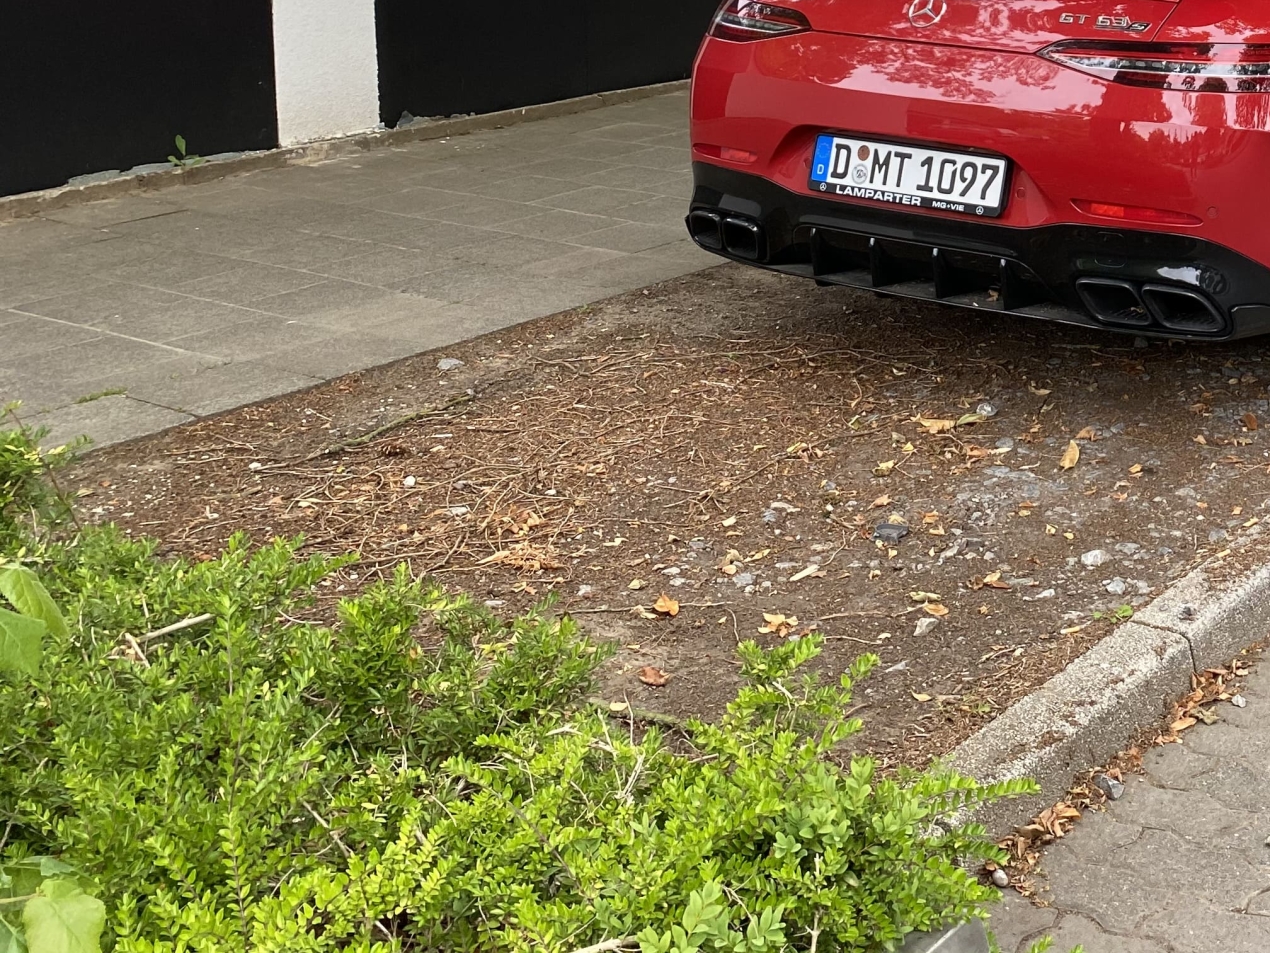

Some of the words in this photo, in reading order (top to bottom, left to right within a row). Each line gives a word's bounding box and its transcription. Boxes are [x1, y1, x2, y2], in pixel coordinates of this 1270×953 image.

[1059, 13, 1091, 24] GT
[816, 164, 825, 175] D
[830, 143, 851, 180] D
[869, 148, 912, 188] MT
[916, 156, 1000, 200] 1097
[835, 184, 921, 207] LAMPARTER
